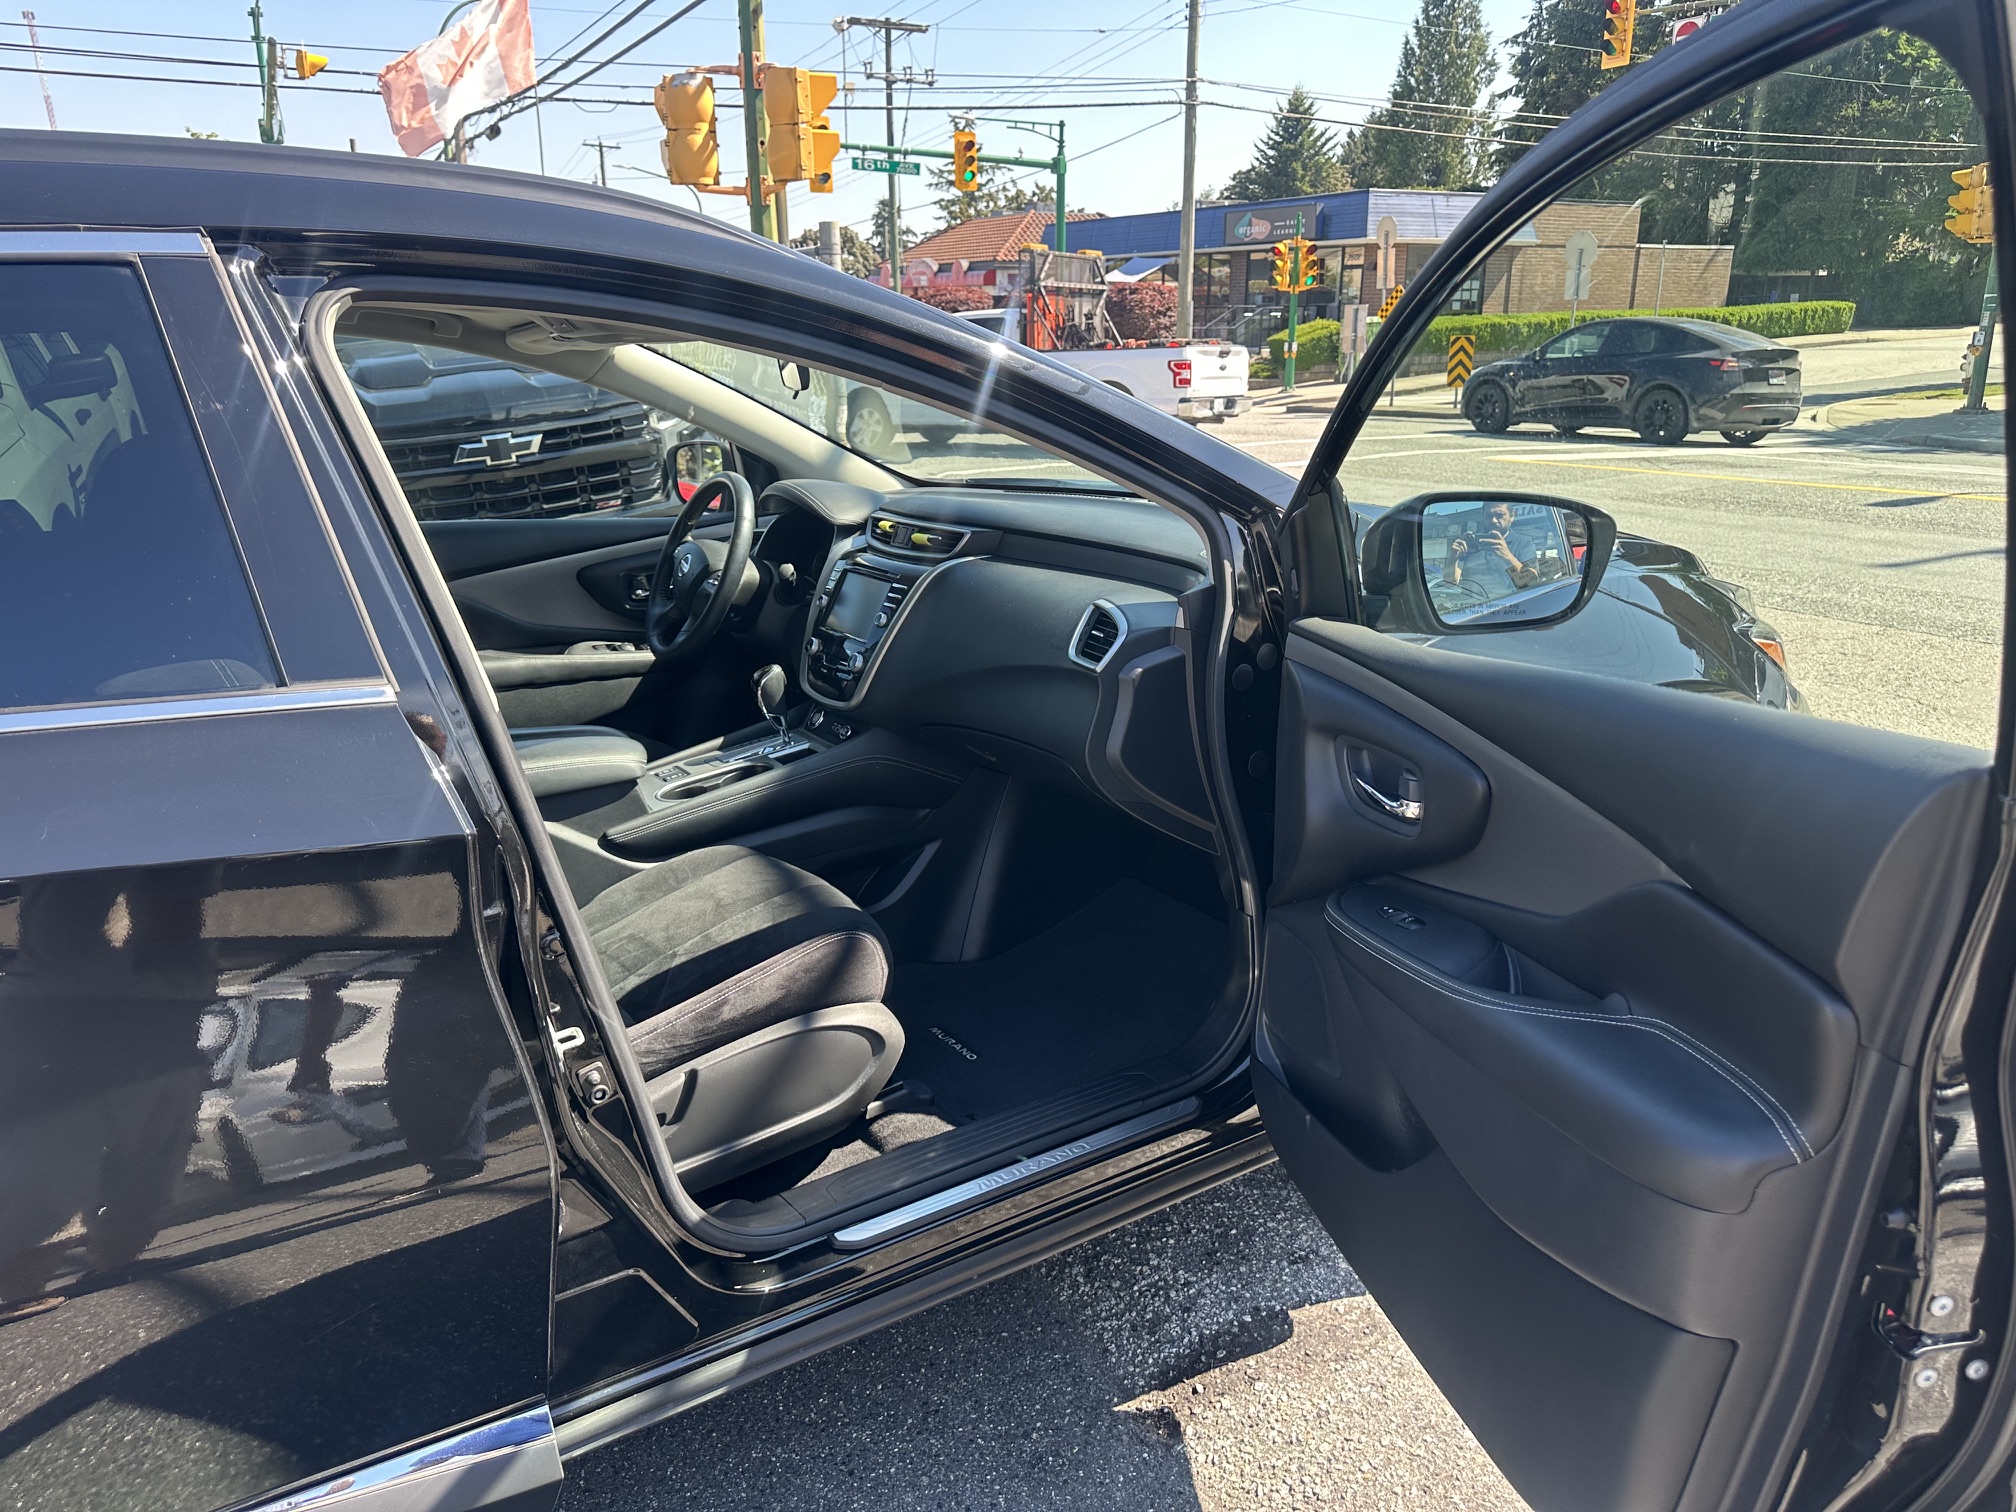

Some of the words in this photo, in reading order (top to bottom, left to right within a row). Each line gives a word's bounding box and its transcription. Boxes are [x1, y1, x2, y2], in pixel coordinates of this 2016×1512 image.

[854, 158, 890, 171] 16th
[1238, 223, 1267, 236] organic
[1273, 227, 1306, 235] LEARNIG
[929, 1027, 977, 1060] MURANO
[978, 1142, 1091, 1191] MURANO
